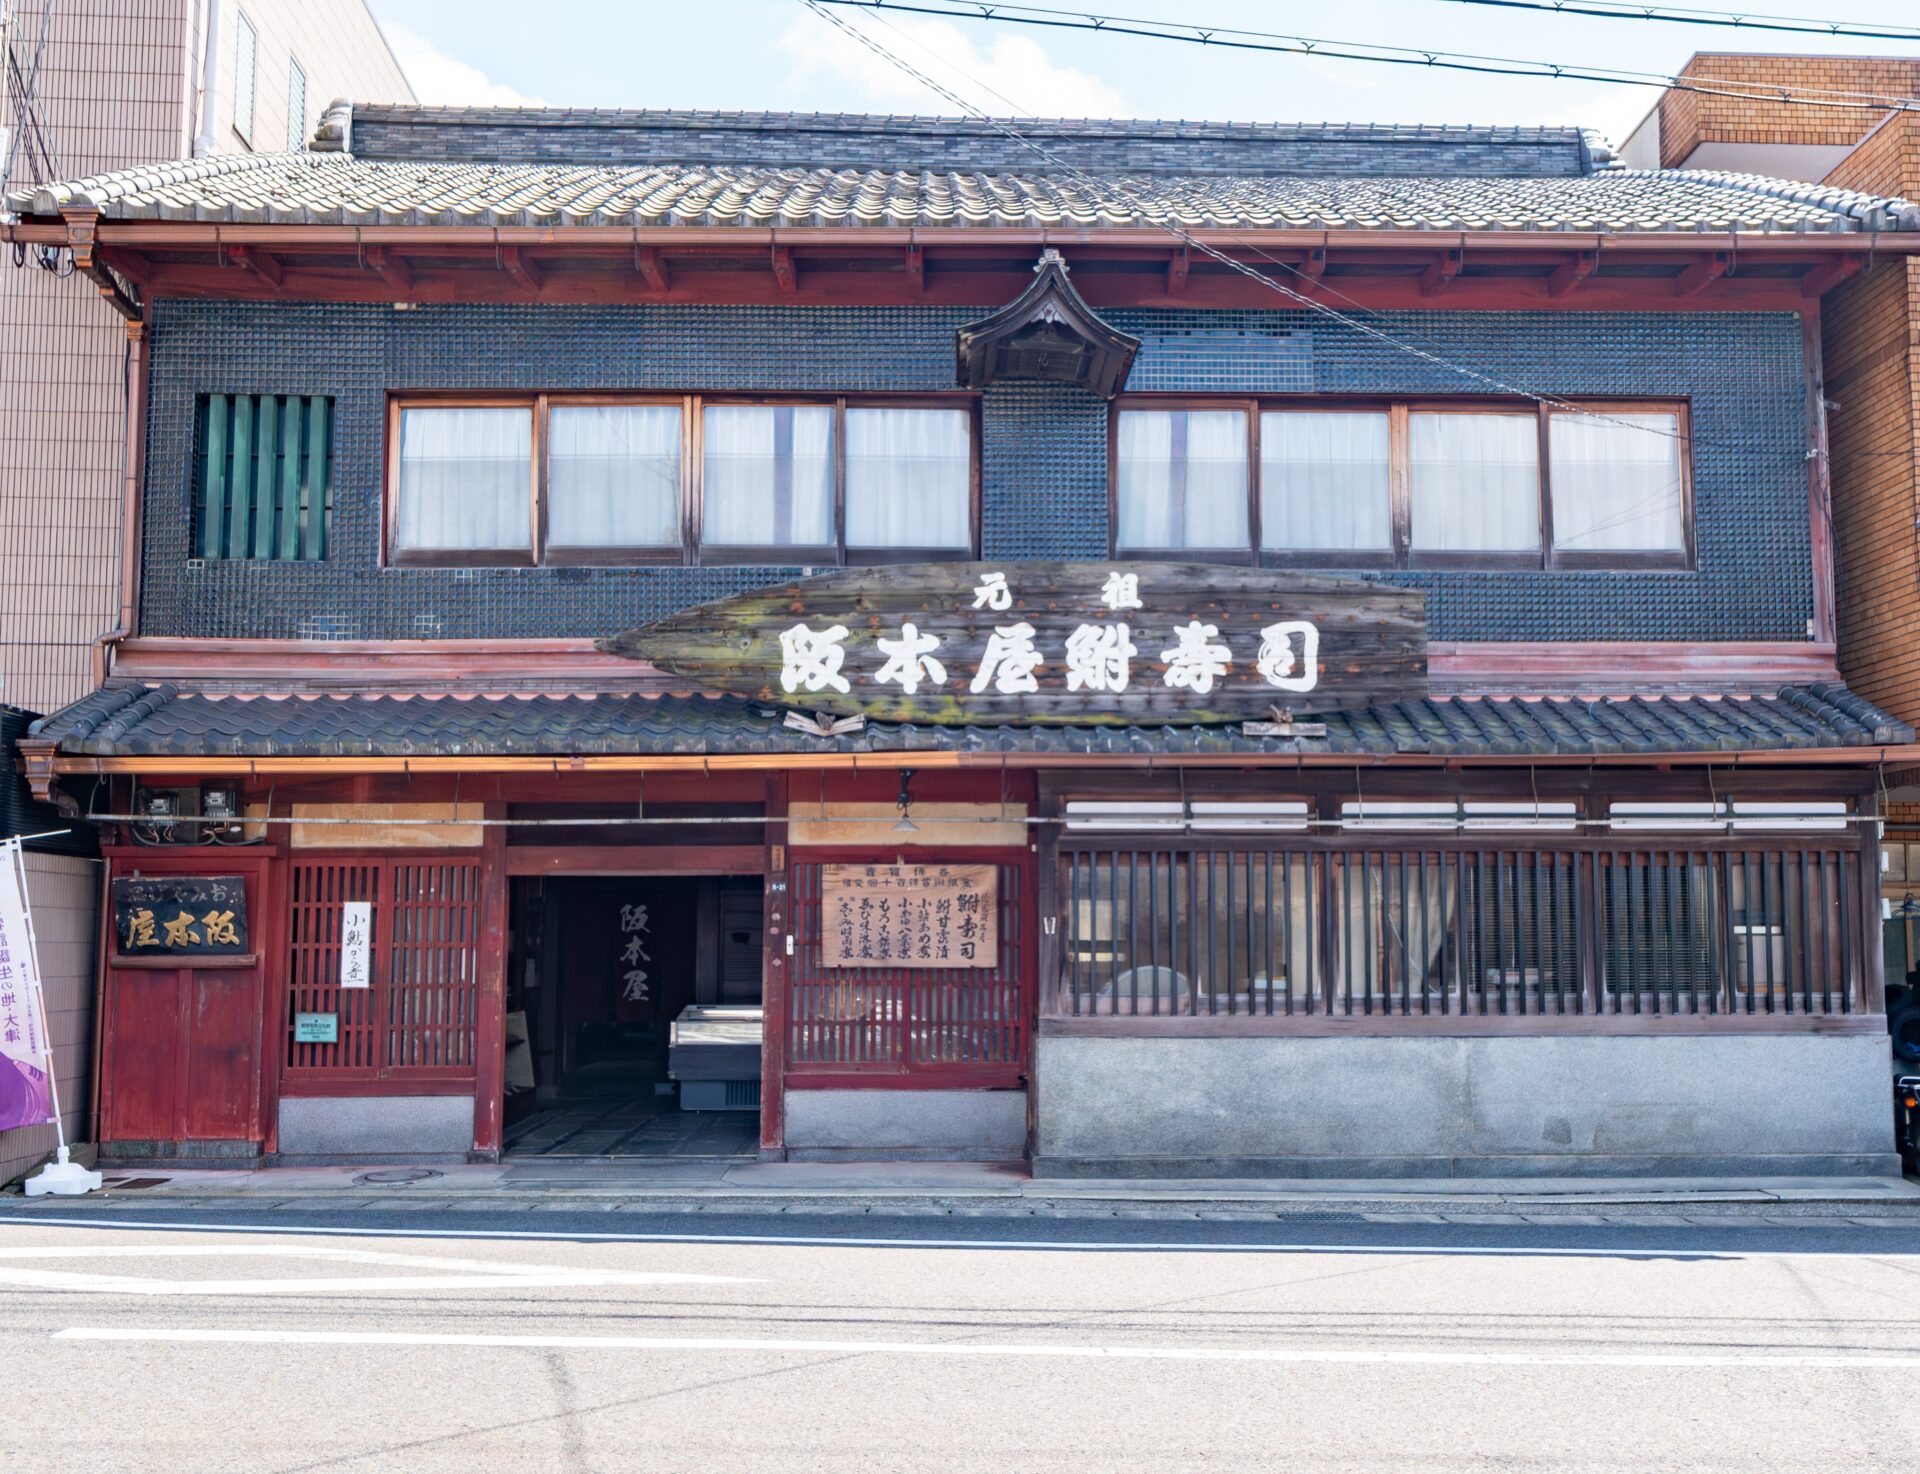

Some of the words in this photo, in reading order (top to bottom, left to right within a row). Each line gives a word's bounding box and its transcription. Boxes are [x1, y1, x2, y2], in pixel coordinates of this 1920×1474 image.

[971, 571, 1143, 610] 元祖
[126, 910, 240, 949] 阪本屋
[620, 904, 651, 1001] 阪本屋
